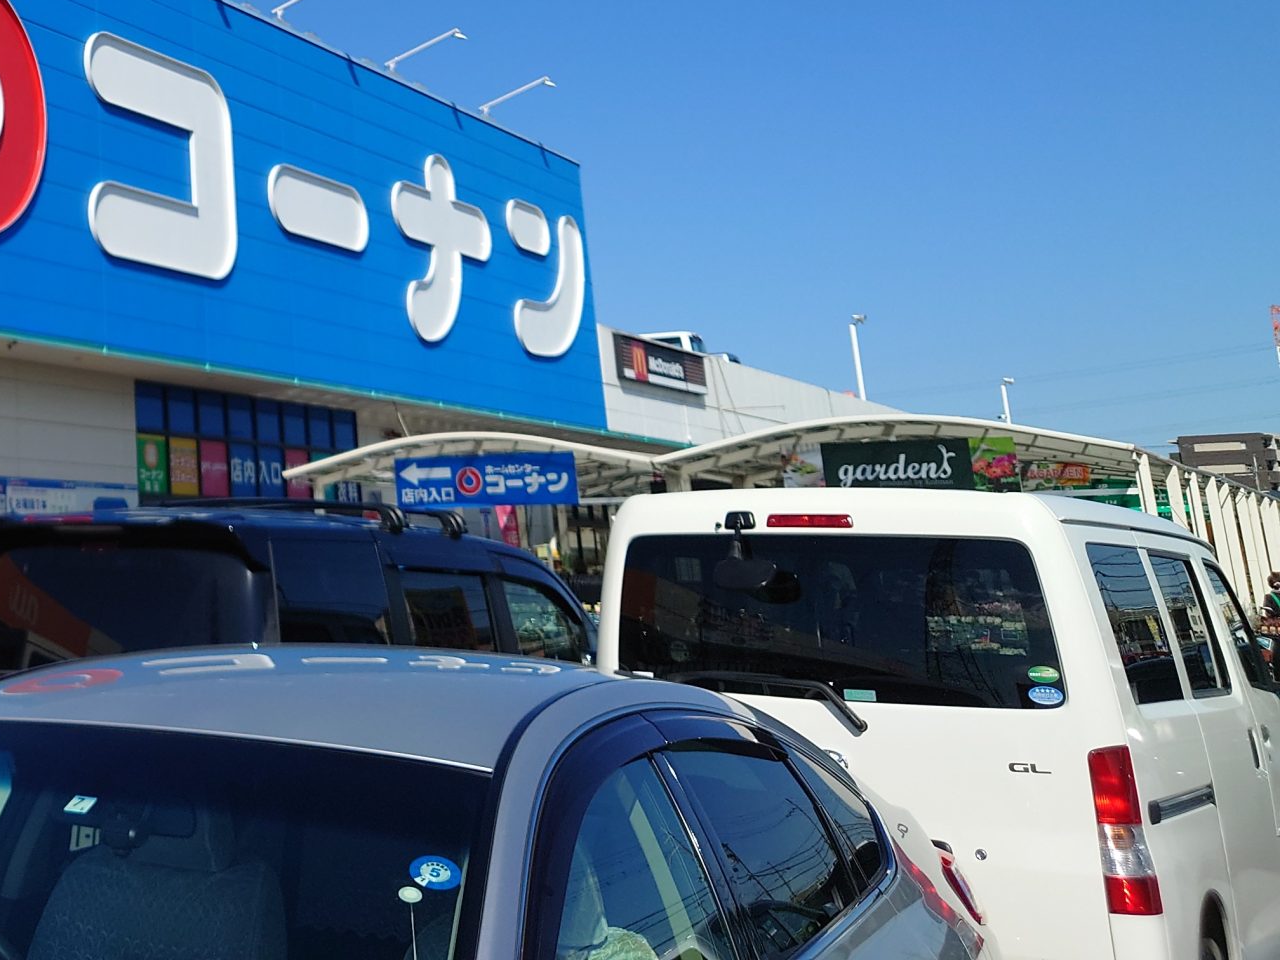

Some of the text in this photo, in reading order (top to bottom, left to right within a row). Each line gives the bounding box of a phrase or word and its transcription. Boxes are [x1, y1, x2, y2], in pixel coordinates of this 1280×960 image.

[84, 31, 586, 358] コーナン
[231, 457, 282, 485] 店内入口
[484, 464, 540, 474] ホームセンター
[838, 444, 956, 488] gardens
[485, 471, 569, 495] コーナン
[401, 487, 455, 504] 店内入口
[1008, 762, 1052, 775] GL
[429, 867, 441, 878] 5
